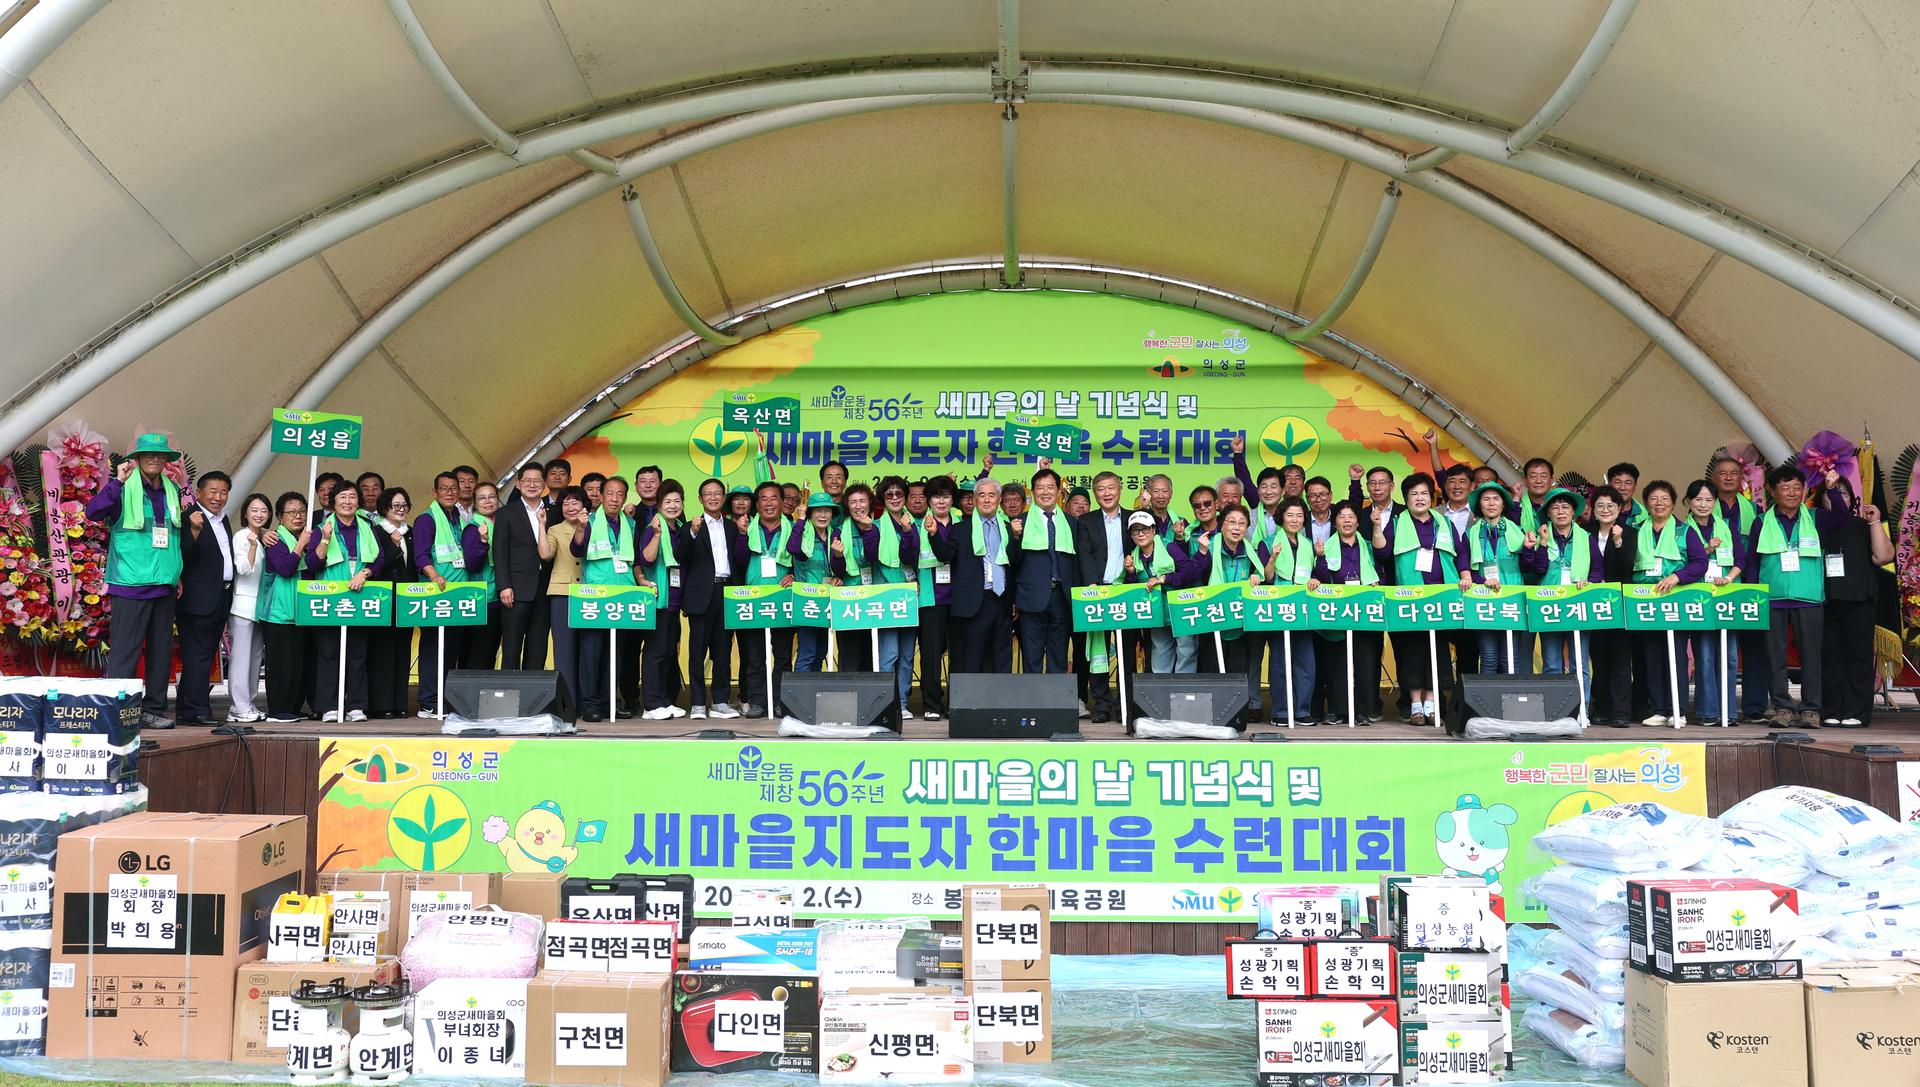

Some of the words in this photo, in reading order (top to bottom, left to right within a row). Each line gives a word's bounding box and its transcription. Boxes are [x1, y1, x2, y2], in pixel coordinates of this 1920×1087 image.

[1144, 340, 1168, 348] 행복한
[1170, 336, 1193, 348] 군민
[1196, 340, 1220, 349] 잘사는
[1223, 337, 1247, 350] 의성
[1204, 359, 1246, 371] 의성군
[810, 394, 866, 408] 새마을운동
[843, 408, 865, 420] 제창
[868, 398, 900, 421] 56
[901, 408, 924, 420] 주년
[935, 391, 1045, 419] 새마을의
[1055, 391, 1080, 419] 날
[1088, 391, 1168, 419] 기념식
[1177, 395, 1199, 419] 및
[732, 407, 791, 425] 옥산면
[282, 426, 352, 450] 의성읍
[1014, 428, 1072, 453] 금성면
[310, 598, 381, 618] 단촌면
[408, 598, 477, 618] 가음면
[580, 602, 647, 621] 봉양면
[842, 601, 908, 620] 사곡면
[1084, 602, 1153, 622] 안평면
[1255, 602, 1307, 622] 신평
[1318, 601, 1384, 622] 안사면
[1540, 601, 1613, 624] 안계면
[1636, 601, 1704, 622] 단밀면
[53, 706, 99, 719] 모나리자
[59, 721, 91, 730] 프레스티지
[46, 748, 106, 758] 의성군새마을회
[431, 751, 499, 769] 의성군
[432, 772, 499, 781] UISEONG-GUN
[707, 762, 794, 782] 새마을운동
[1504, 768, 1546, 784] 행복한
[1549, 763, 1588, 784] 군민
[1594, 768, 1636, 784] 잘사는
[1640, 762, 1681, 785] 의성
[759, 784, 794, 803] 제창
[798, 769, 849, 807] 56
[851, 784, 885, 804] 주년
[902, 759, 1078, 806] 새마을의
[1092, 759, 1134, 807] 날
[1147, 759, 1275, 807] 기념식
[1287, 766, 1322, 807] 및
[274, 841, 284, 859] LG
[624, 812, 972, 870] 새마을지도자
[987, 813, 1156, 872] 한마음
[1174, 815, 1406, 873] 수련대회
[146, 854, 171, 870] LG
[110, 888, 176, 899] 의성군새마을회
[910, 892, 934, 906] 장소
[334, 908, 378, 926] 안사면
[1438, 902, 1450, 916] 증
[448, 915, 509, 927] 안평면
[1279, 912, 1337, 925] 성광기획
[976, 923, 1038, 944] 단북면
[1415, 922, 1474, 936] 의성농협
[332, 939, 376, 956] 안사면
[547, 936, 609, 959] 점곡면
[610, 936, 672, 959] 점곡면
[698, 942, 726, 950] smato
[1706, 928, 1772, 952] 의성군새마을회
[1240, 959, 1298, 972] 성광기획
[1324, 958, 1384, 971] 성광기획
[1240, 975, 1300, 990] 손학익
[1324, 974, 1385, 990] 손학익
[1418, 984, 1487, 1004] 의성군새마을회
[437, 1010, 506, 1020] 의성군새마을회
[718, 1012, 781, 1036] 다인면
[977, 1004, 1040, 1027] 단북면
[444, 1022, 500, 1038] 부녀회장
[558, 1026, 624, 1050] 구천면
[1265, 1026, 1285, 1034] IRON
[869, 1034, 934, 1057] 신평면
[1726, 1034, 1768, 1046] Kosten
[288, 1044, 332, 1070] 계면
[1293, 1040, 1365, 1063] 의성군새마을회
[1736, 1046, 1758, 1054] 코스텐
[1888, 1048, 1912, 1056] 코스텐
[1419, 1052, 1488, 1074] 의성군새마을회
